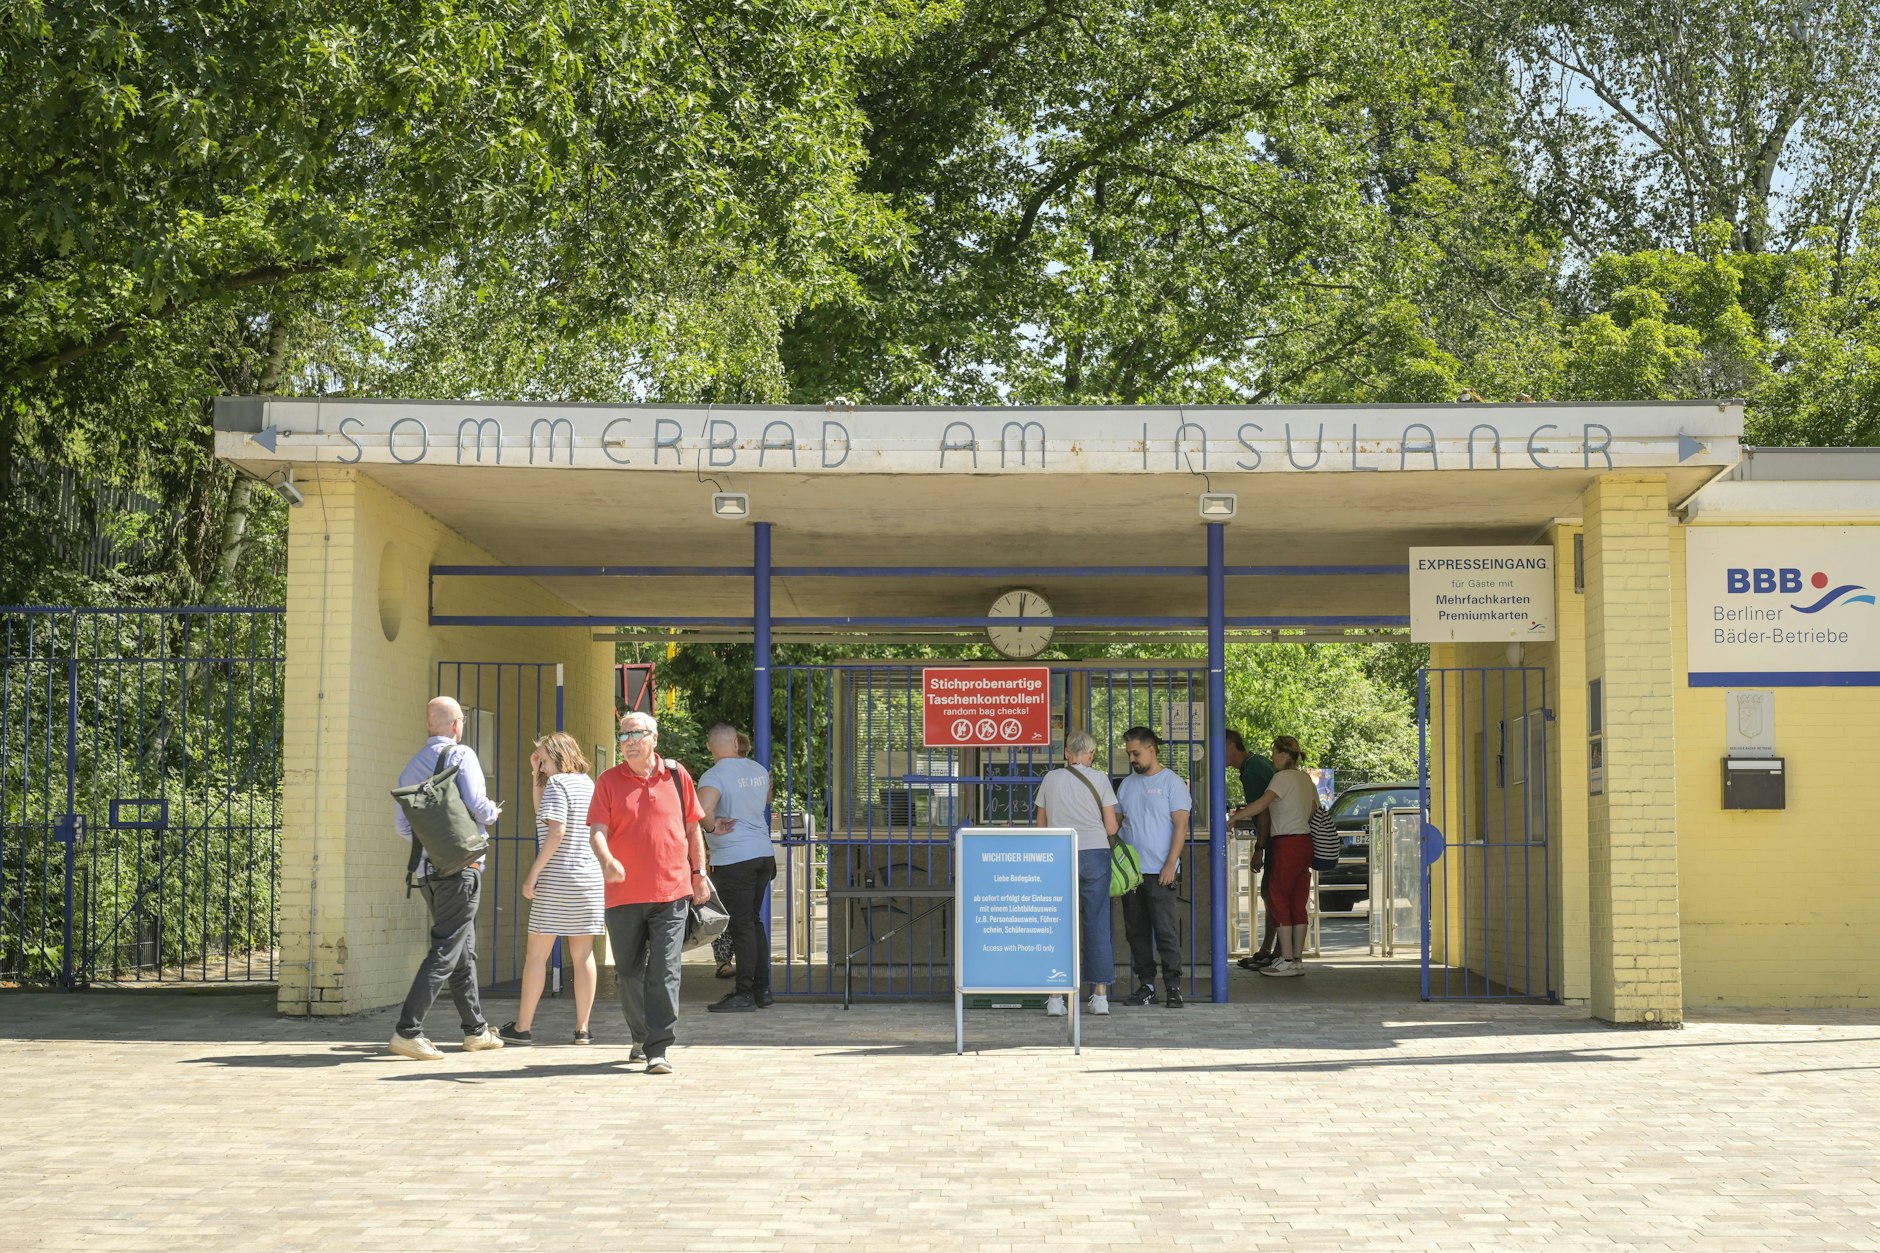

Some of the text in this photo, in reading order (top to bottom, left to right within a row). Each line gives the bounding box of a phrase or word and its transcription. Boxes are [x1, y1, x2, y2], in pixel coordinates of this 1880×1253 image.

[336, 417, 1613, 471] SOMMERBAD AM INSULANER
[1418, 558, 1547, 571] EXPRESSEINGANG
[1451, 579, 1514, 588] für Gäste mit
[1727, 568, 1803, 594] BBB
[1436, 594, 1530, 605] Mehrfachkarten
[1438, 610, 1528, 621] Premiumkarten
[1713, 605, 1784, 621] Berliner
[1714, 628, 1849, 644] Bäder-Betriebe
[930, 678, 1042, 691] Stichprobenartige
[927, 693, 1045, 705] Taschenkontrollen!
[943, 706, 1029, 717] random bag checks!
[982, 853, 1054, 862] WICHTIGER HINWEIS
[993, 874, 1042, 883] Liebe Badegäste,
[1000, 895, 1020, 903] erfolgt
[979, 905, 1057, 913] mit einem Lichtbildausweis
[989, 916, 1039, 924] Personalausweis,
[1040, 915, 1062, 924] Führer-
[983, 926, 1004, 934] schein,
[982, 944, 1055, 953] Access with Photo-ID only
